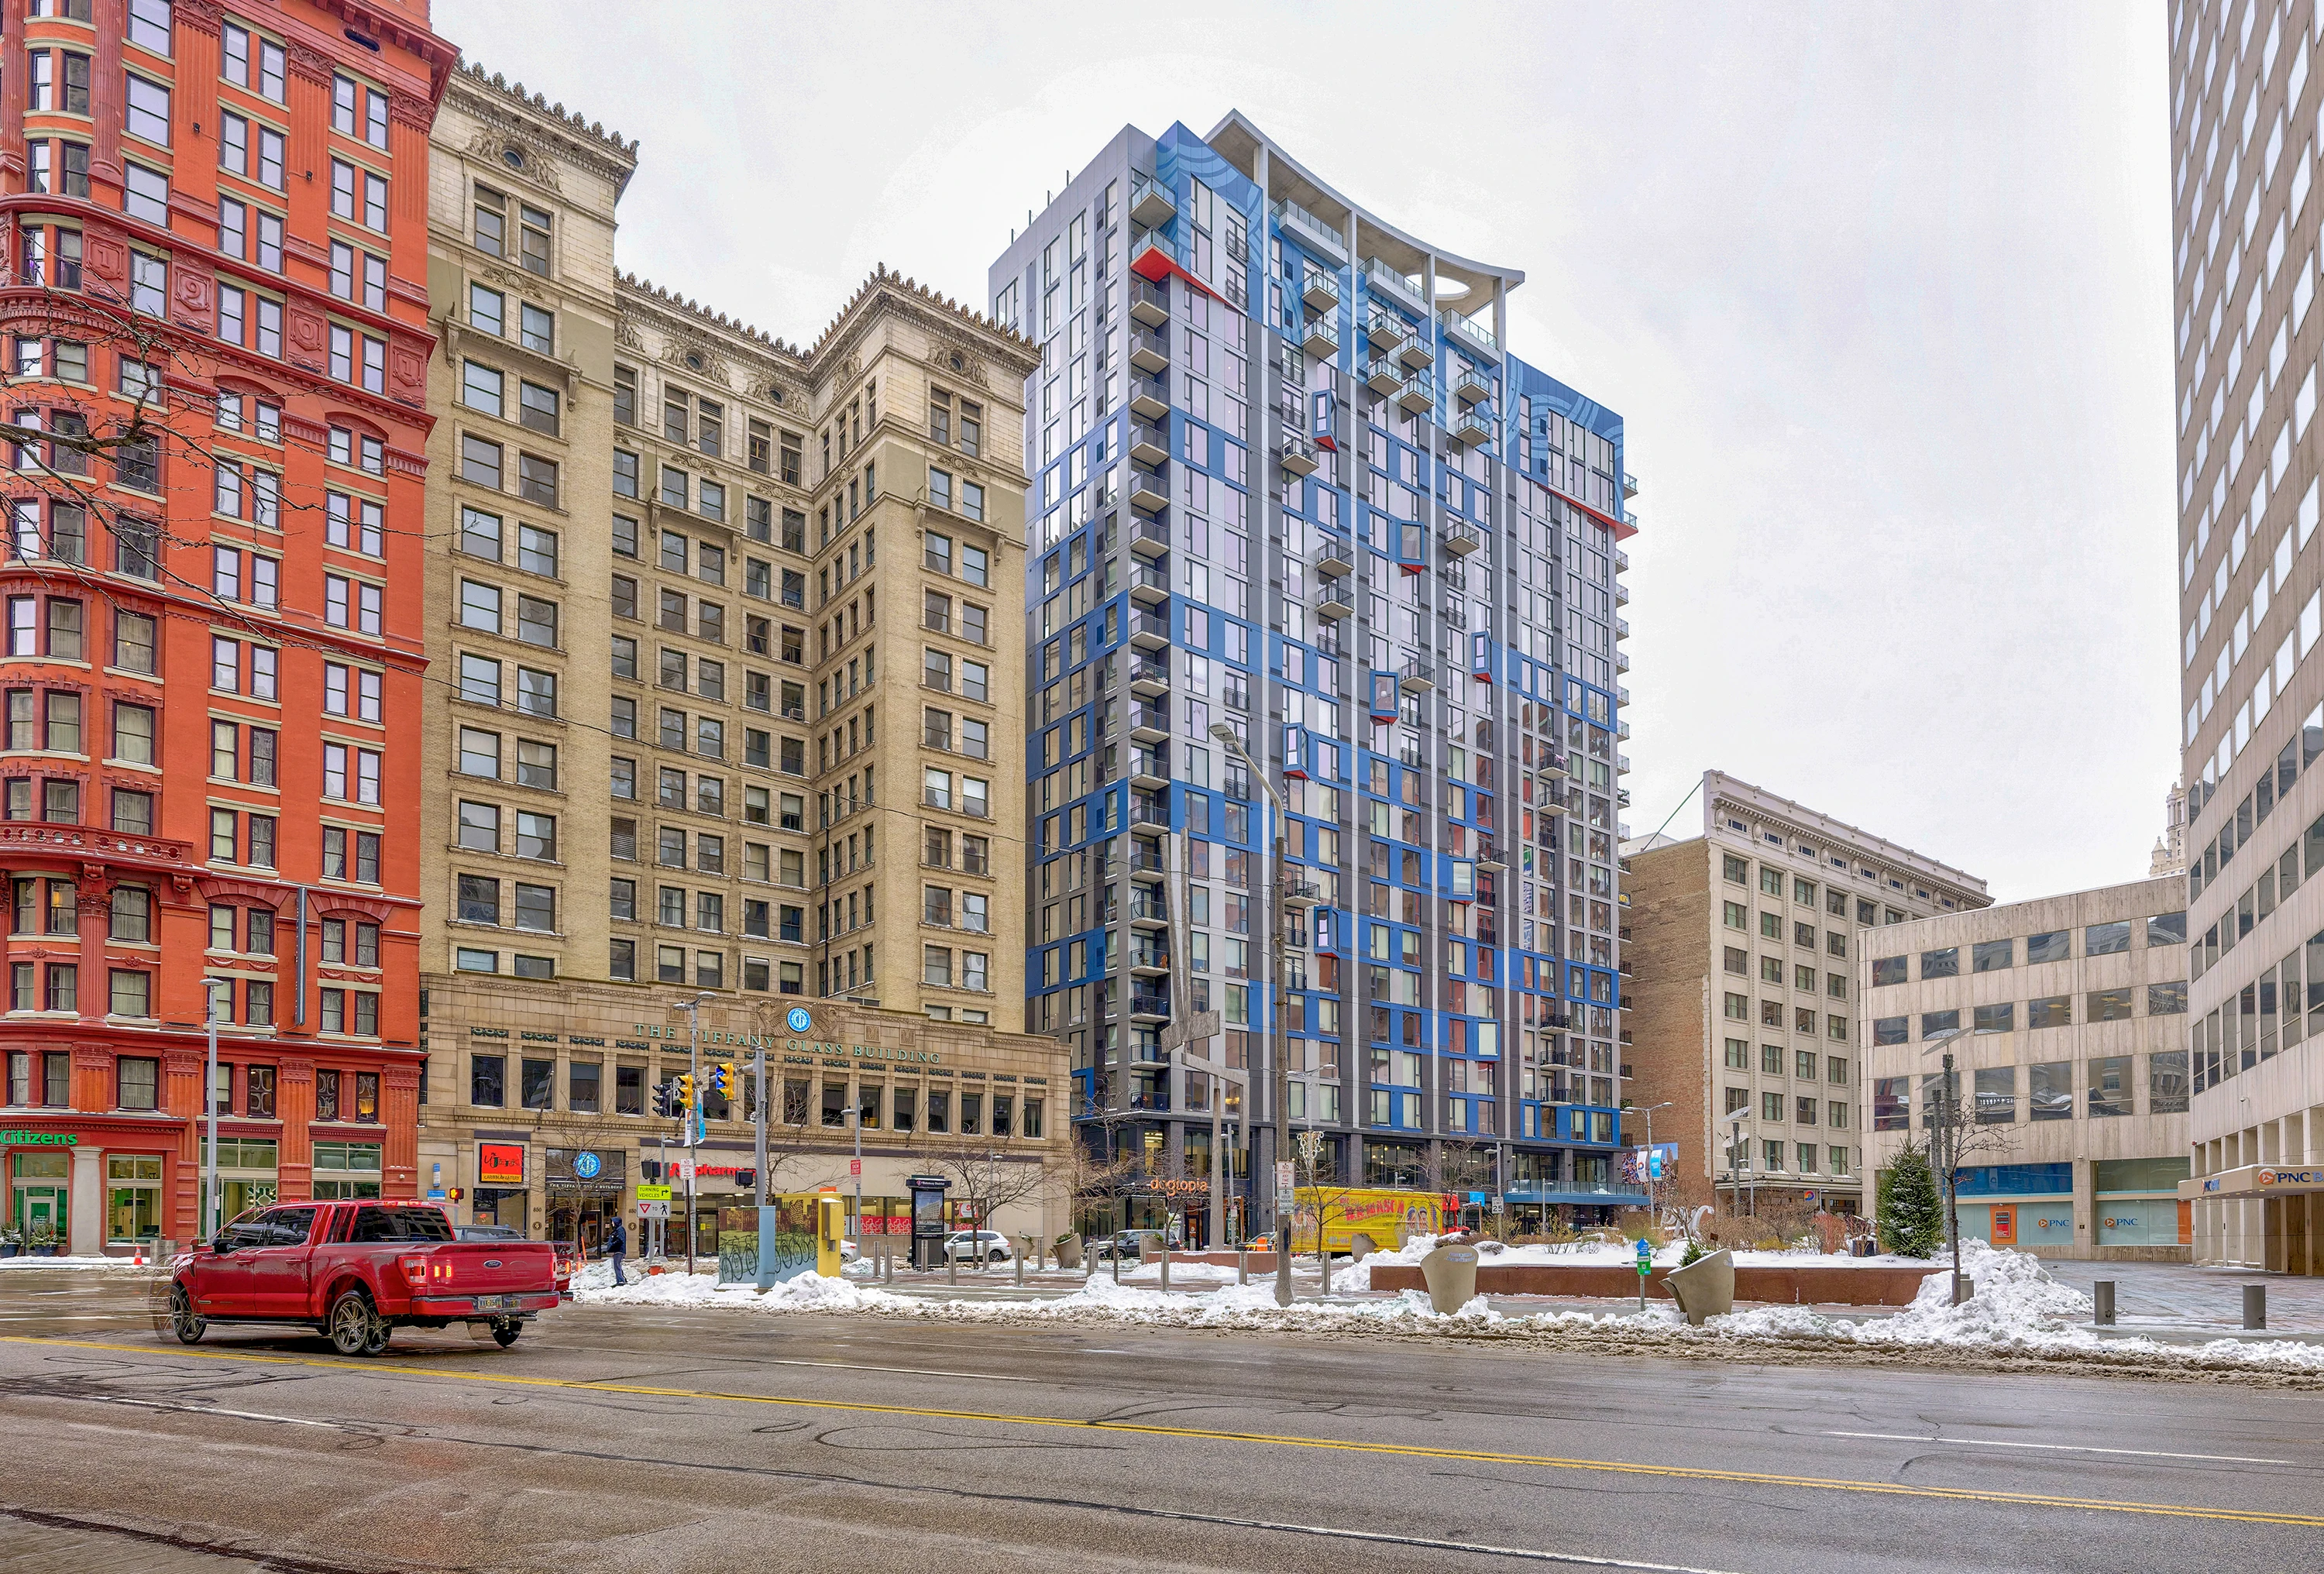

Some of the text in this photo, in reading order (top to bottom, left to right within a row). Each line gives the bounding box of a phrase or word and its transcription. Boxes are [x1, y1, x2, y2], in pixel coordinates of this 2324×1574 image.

[634, 1023, 677, 1040] THE
[786, 1039, 844, 1055] GLASS
[854, 1046, 940, 1064] BUILDING
[0, 1129, 77, 1145] Citizens
[695, 1163, 757, 1177] pharm
[2278, 1172, 2324, 1183] PNC B
[1150, 1176, 1208, 1196] dogtopia
